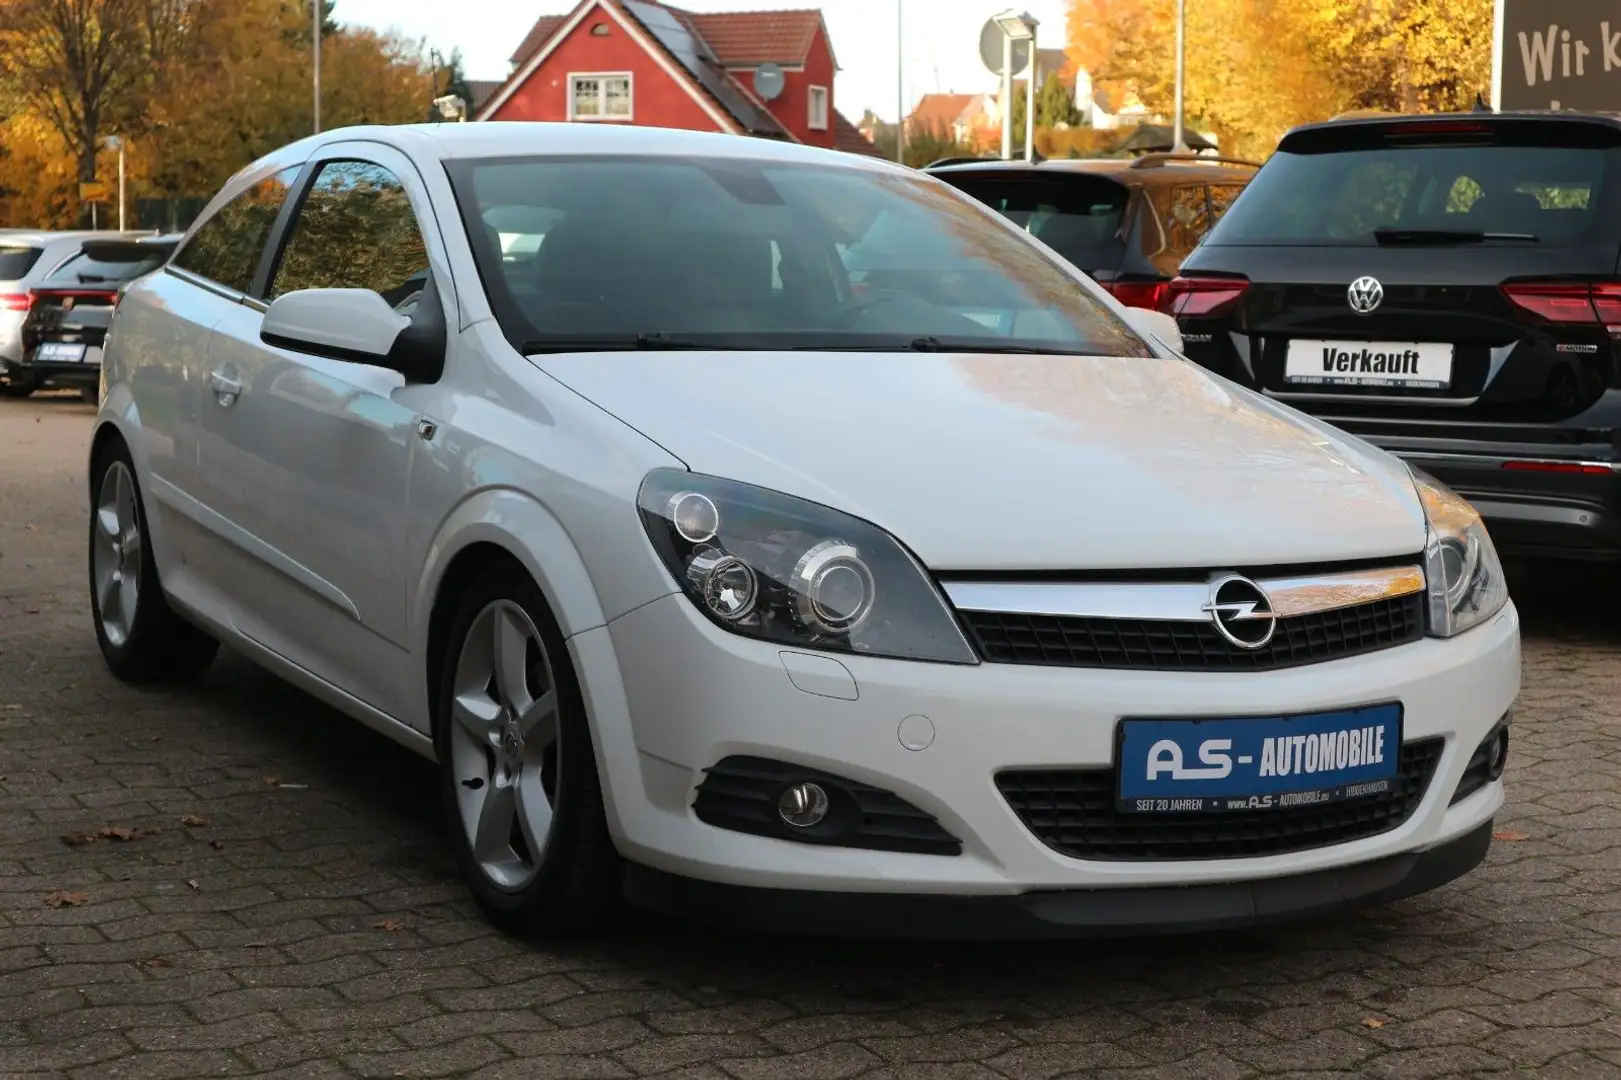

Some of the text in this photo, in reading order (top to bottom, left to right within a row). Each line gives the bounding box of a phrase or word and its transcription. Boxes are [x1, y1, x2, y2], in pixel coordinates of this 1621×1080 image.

[1517, 24, 1590, 86] Wir
[1322, 347, 1420, 374] Verkauft
[1136, 798, 1203, 811] SEIT 20 JAHREN
